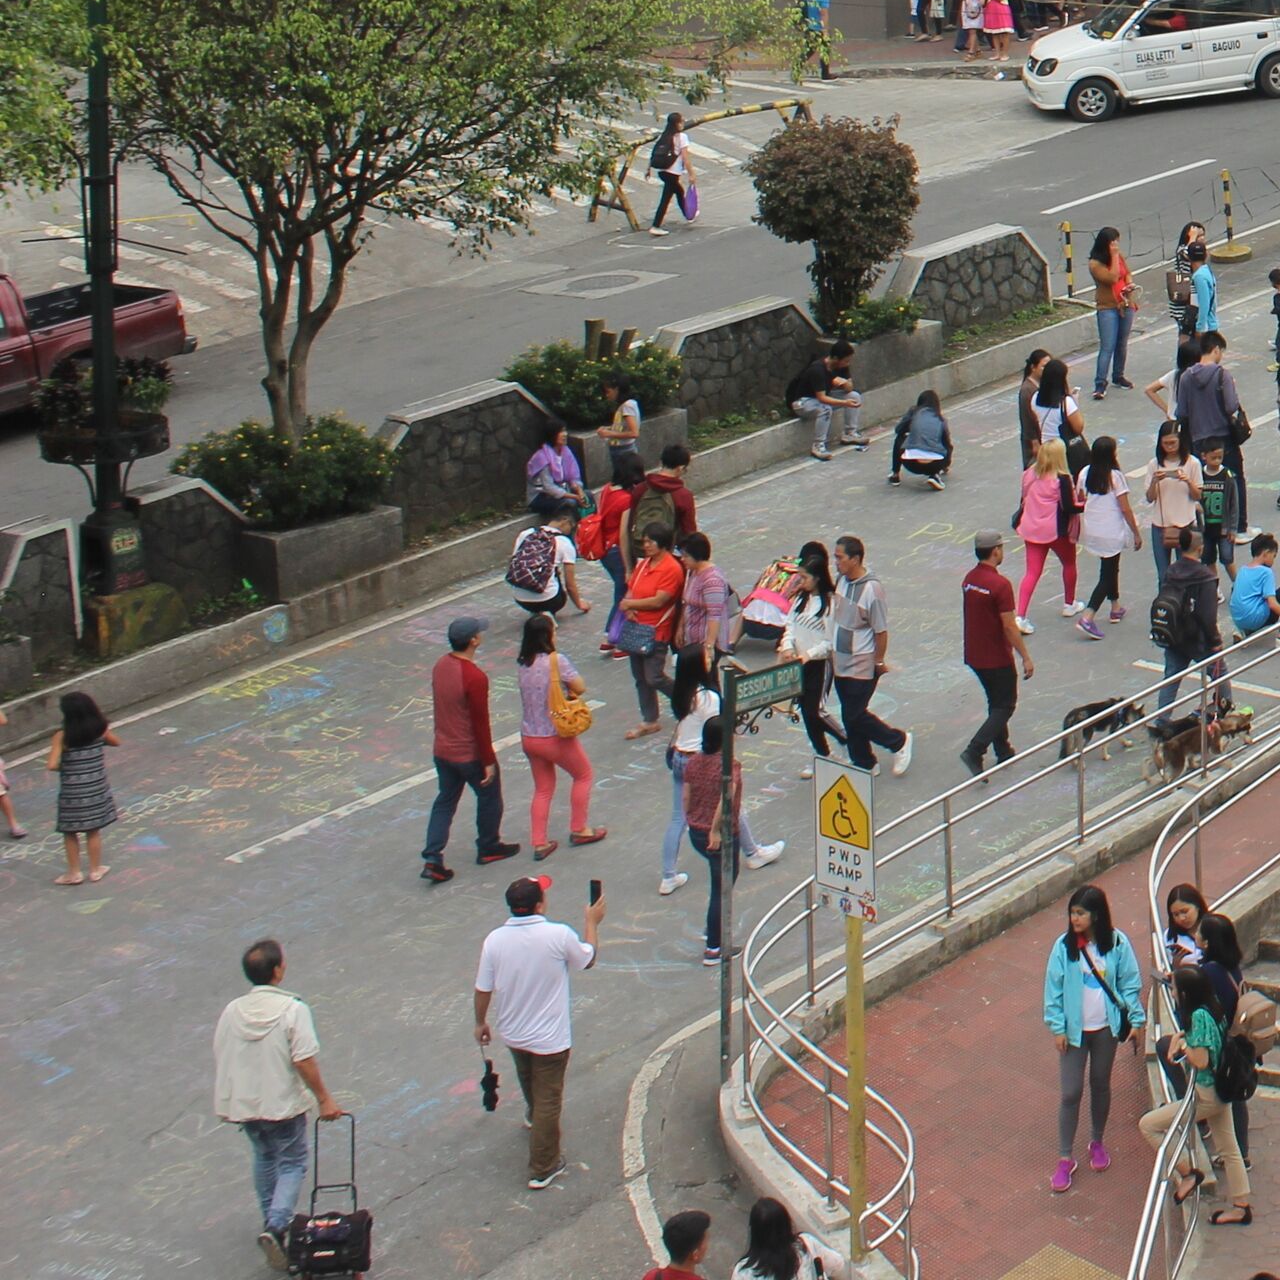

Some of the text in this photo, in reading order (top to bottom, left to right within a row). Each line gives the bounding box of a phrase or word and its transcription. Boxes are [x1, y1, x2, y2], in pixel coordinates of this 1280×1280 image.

[1212, 40, 1241, 52] BAGUIO
[1136, 49, 1175, 63] ELIAS LETTY
[737, 674, 773, 699] SESSION
[777, 666, 800, 687] ROAD
[828, 862, 863, 882] RAMP
